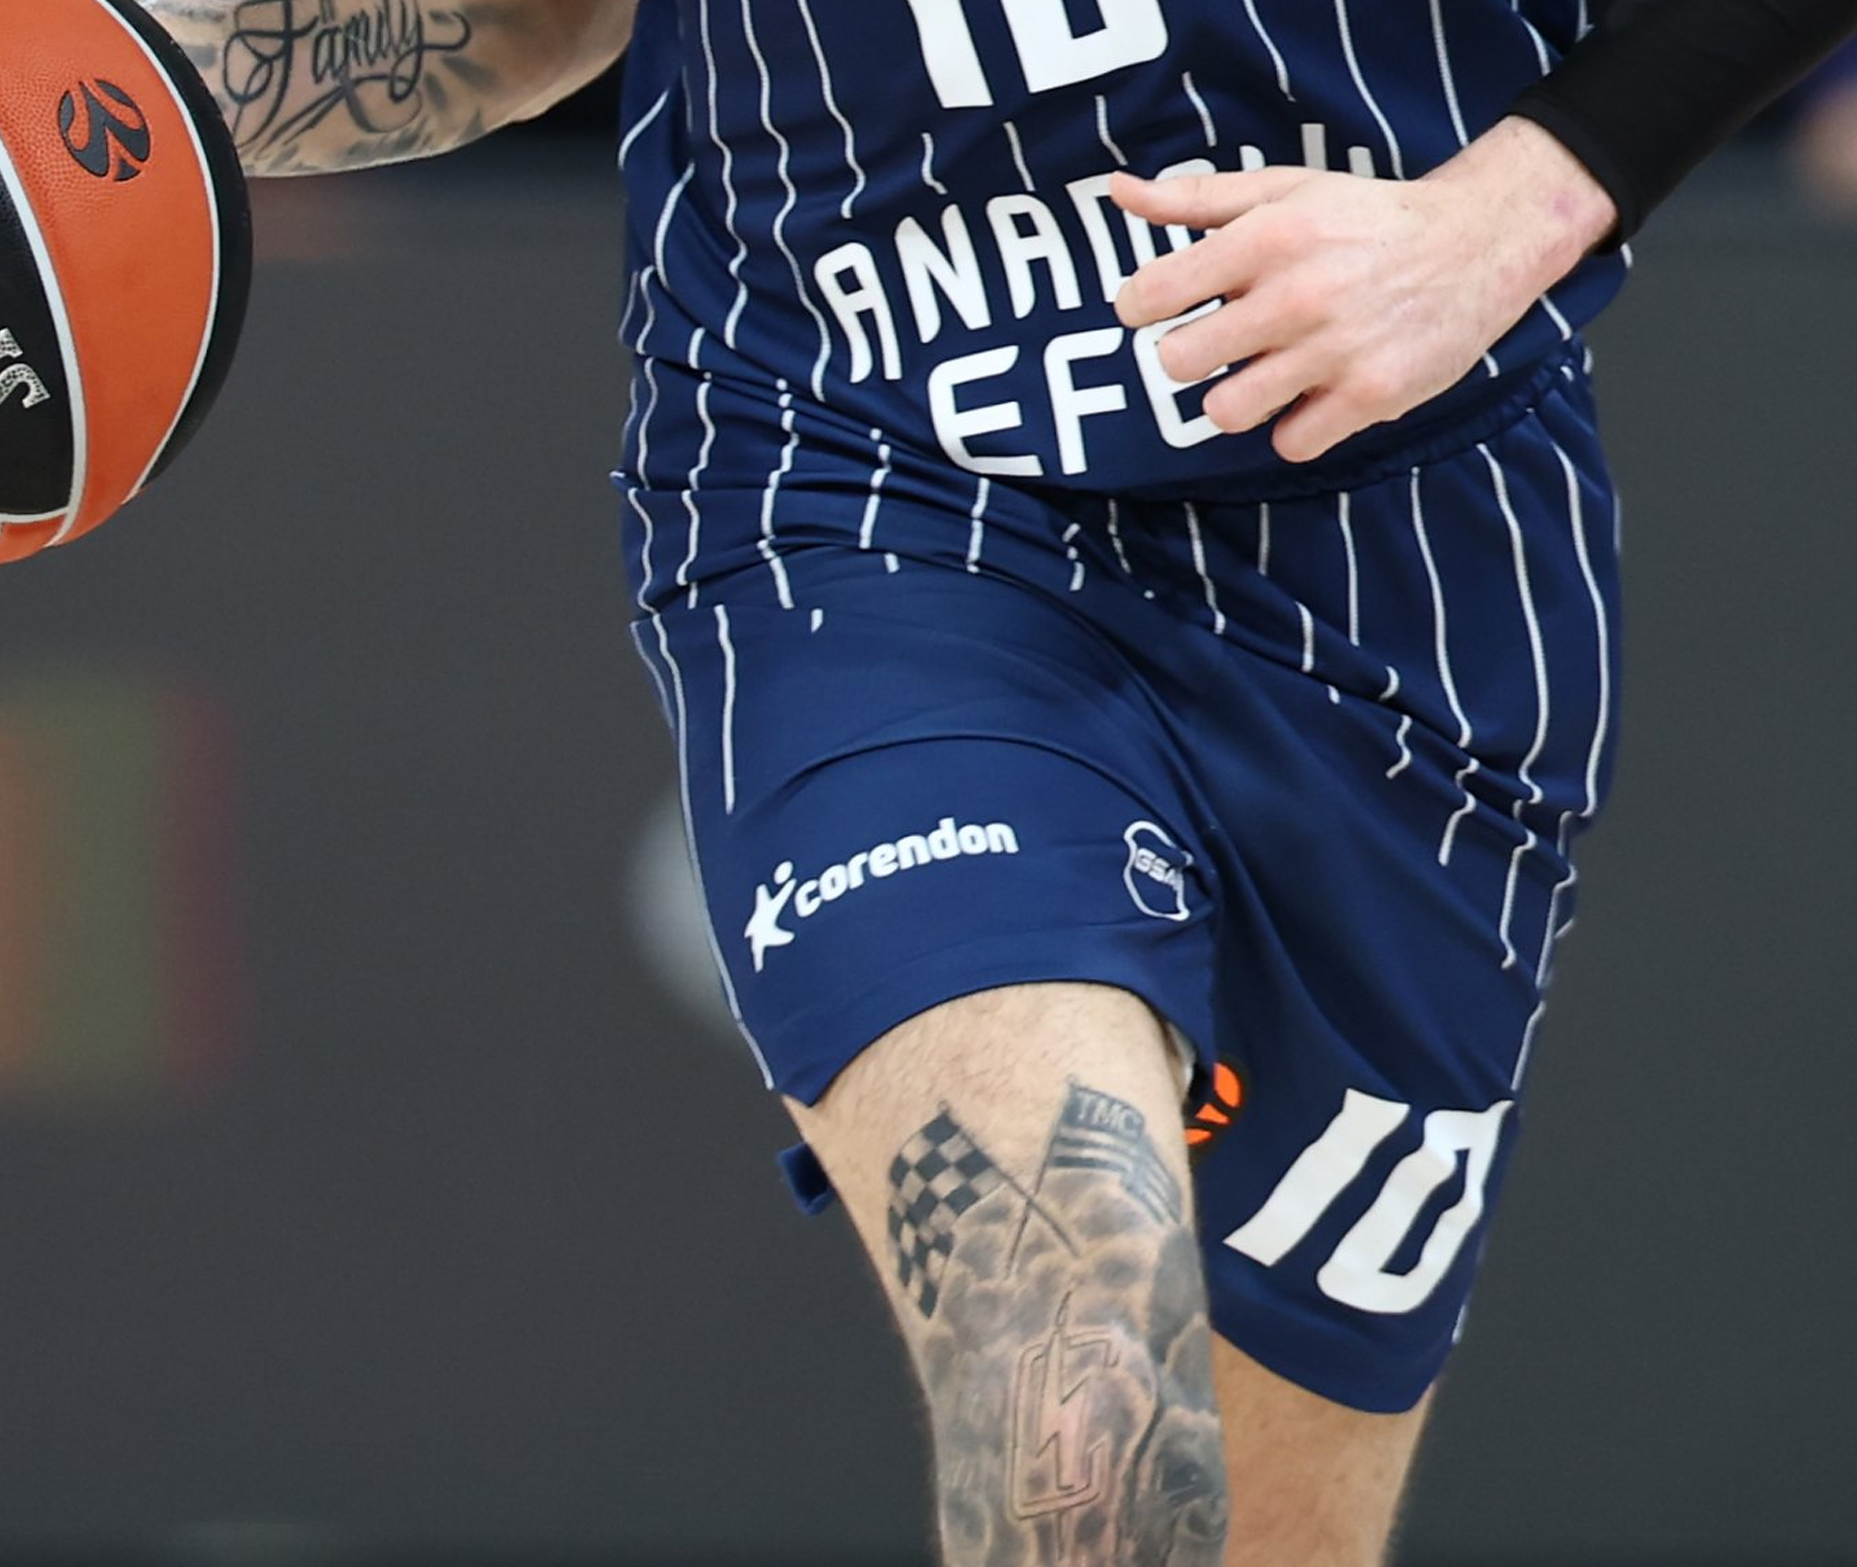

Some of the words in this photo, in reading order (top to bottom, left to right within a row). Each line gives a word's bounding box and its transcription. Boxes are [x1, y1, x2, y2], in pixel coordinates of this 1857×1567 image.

[813, 123, 1375, 383] ANAD
[927, 298, 1230, 476] EFE
[794, 816, 1020, 918] corendon
[1134, 847, 1184, 892] GSA
[1223, 1087, 1516, 1315] 10
